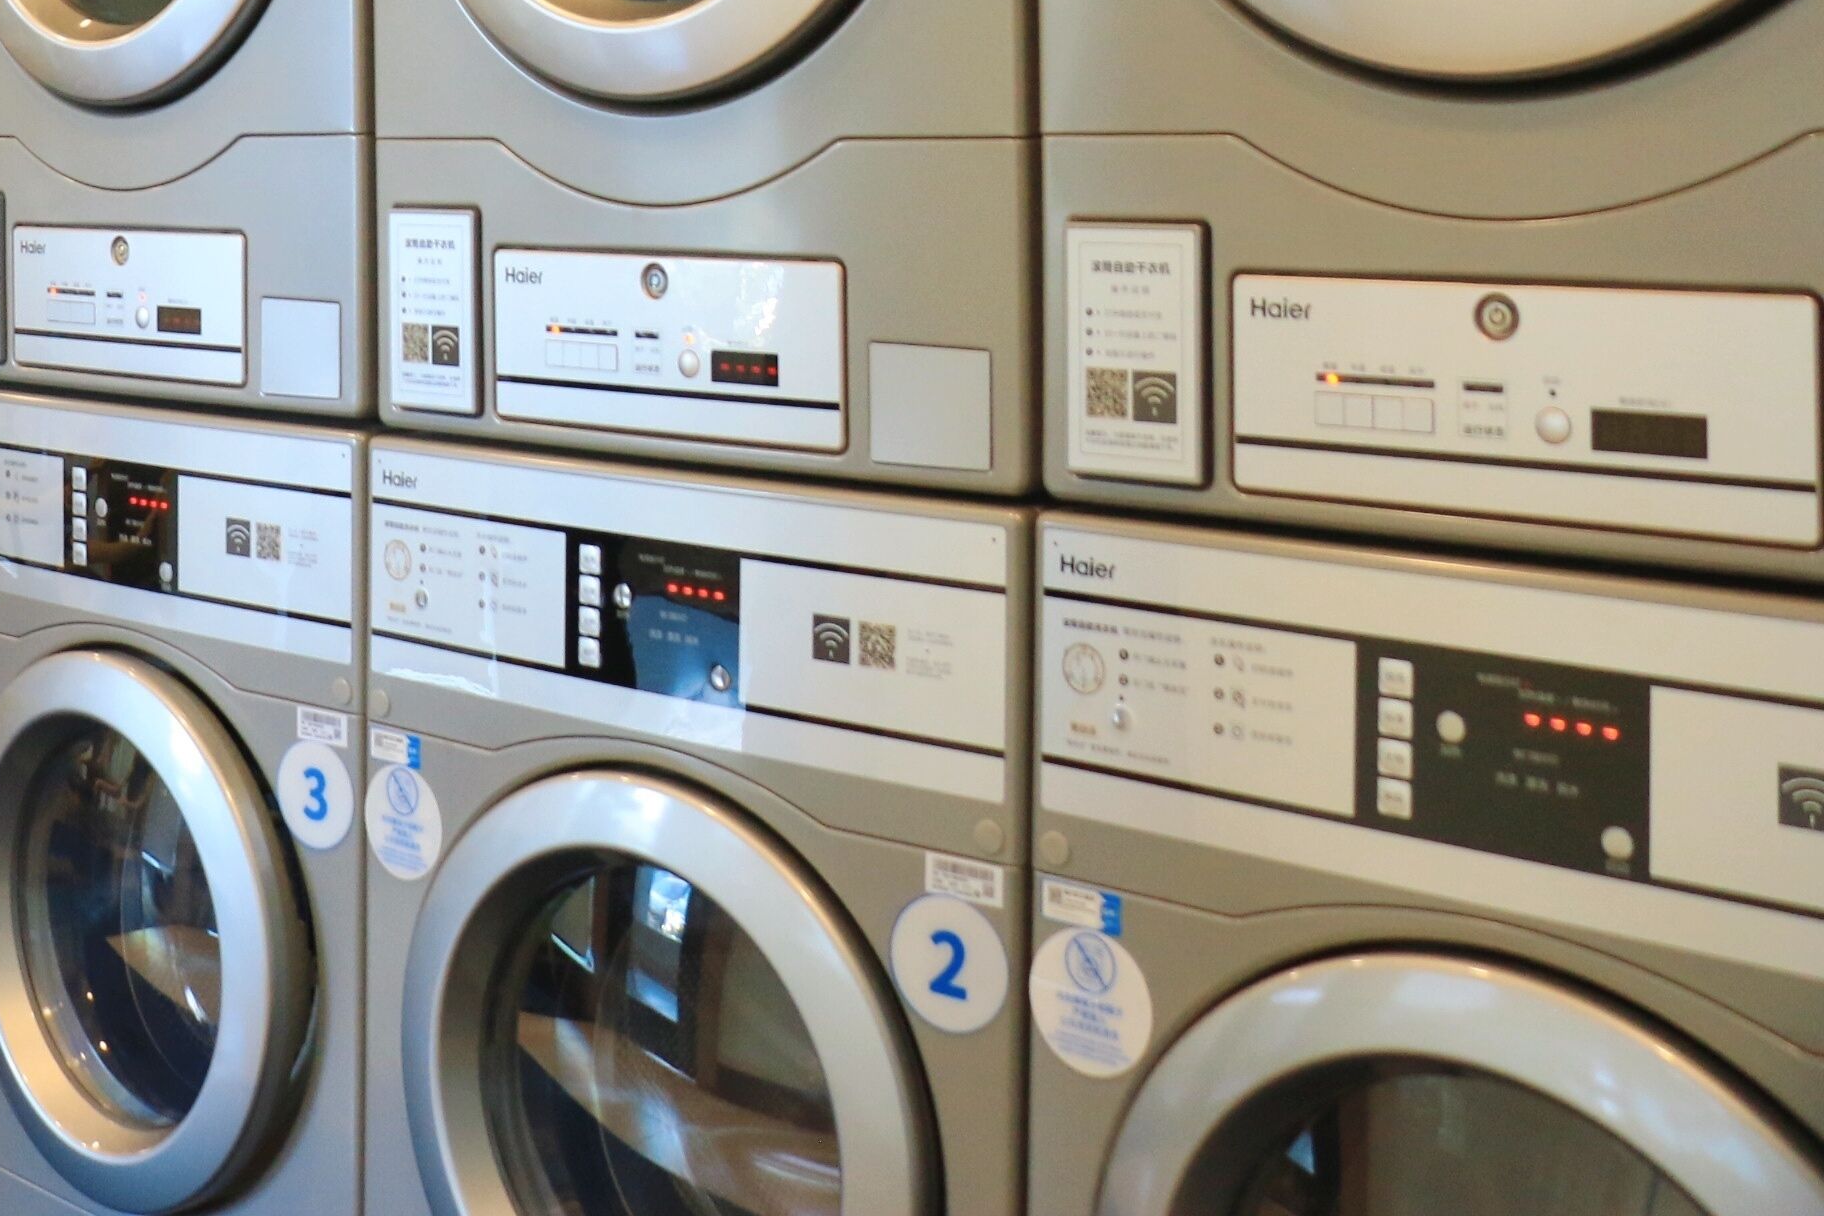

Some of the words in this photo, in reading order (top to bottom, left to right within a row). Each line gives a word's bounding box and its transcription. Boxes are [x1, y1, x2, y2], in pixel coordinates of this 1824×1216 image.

[20, 241, 46, 255] Haier
[504, 266, 543, 285] Haier
[1249, 297, 1312, 320] Haier
[382, 469, 418, 489] Haier
[1060, 554, 1116, 580] Haier
[303, 767, 330, 822] 3
[929, 930, 968, 1002] 2
